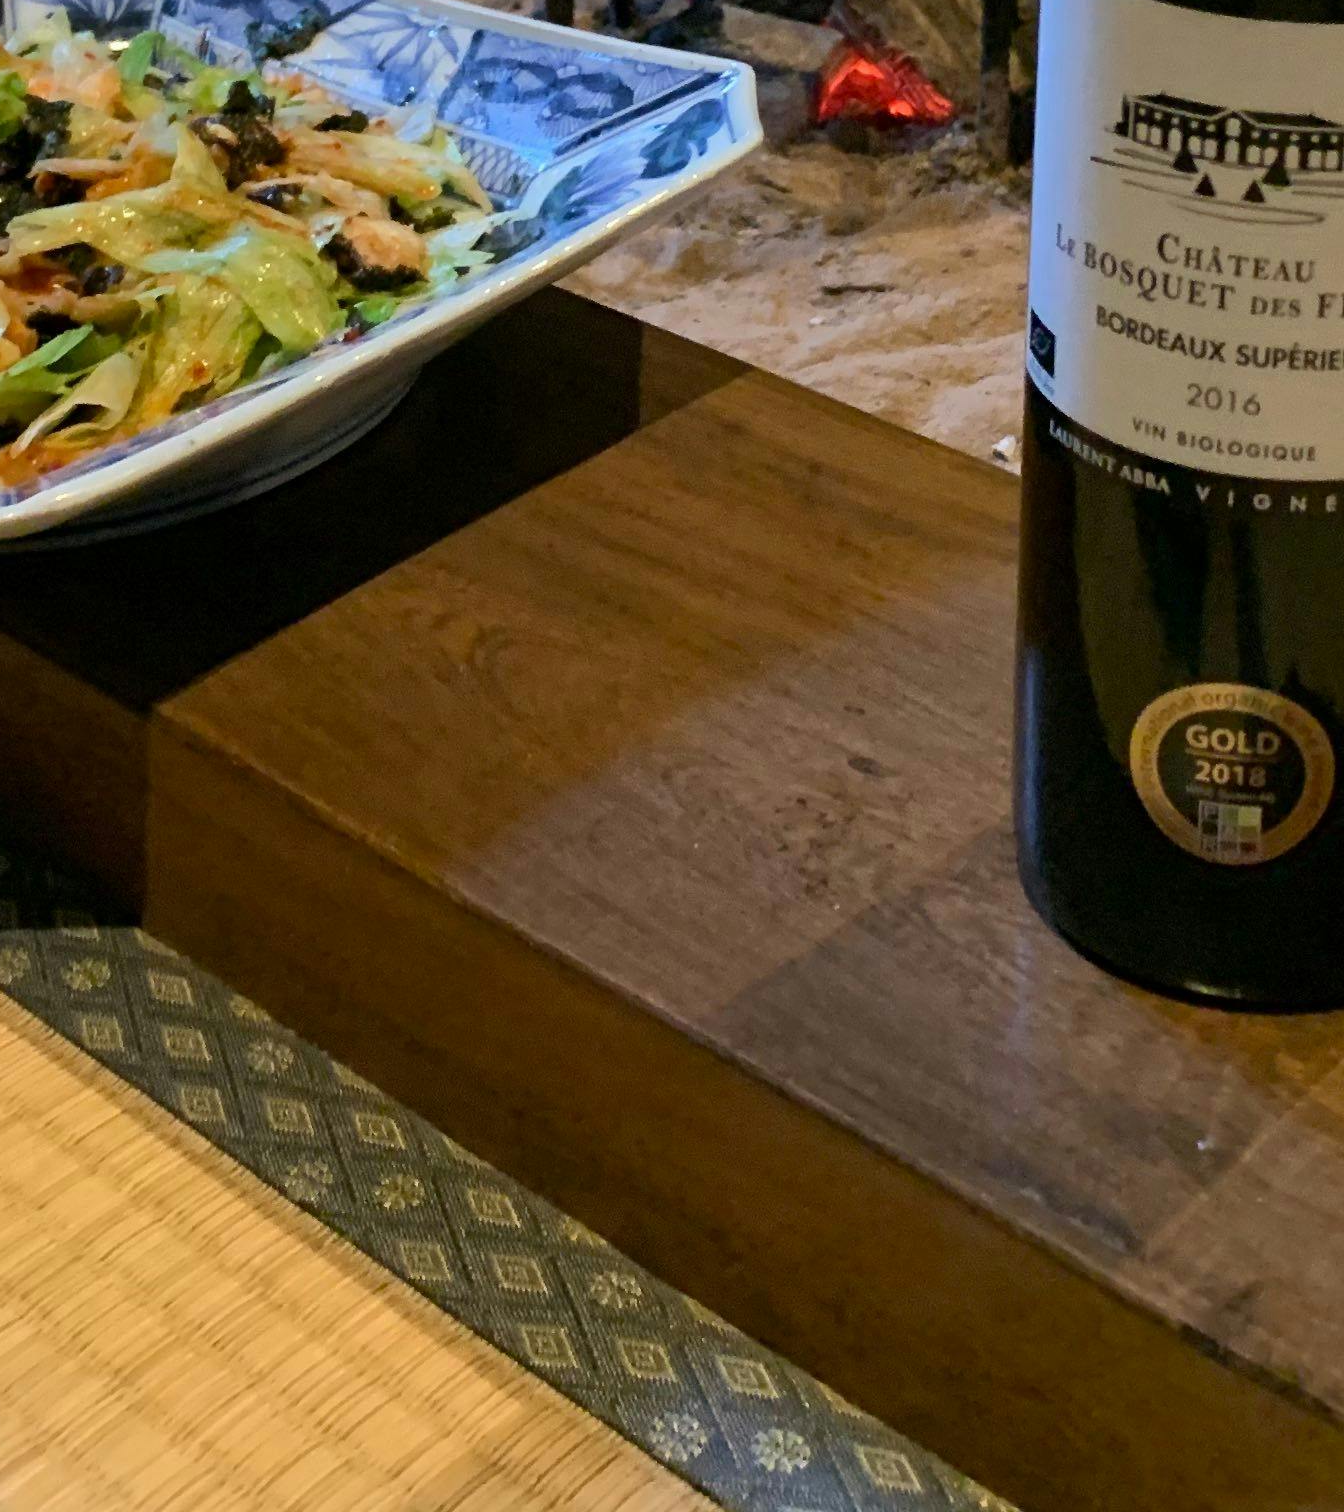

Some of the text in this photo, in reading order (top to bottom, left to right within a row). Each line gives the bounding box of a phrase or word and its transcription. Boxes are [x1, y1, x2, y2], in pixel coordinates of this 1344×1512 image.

[1084, 241, 1237, 312] BOSQUET
[1250, 294, 1302, 319] DES
[1096, 304, 1226, 365] BORDEAUX
[1186, 382, 1263, 418] 2016
[1132, 416, 1317, 463] VIN BIOLOGIQUE
[1185, 724, 1283, 757] GOLD
